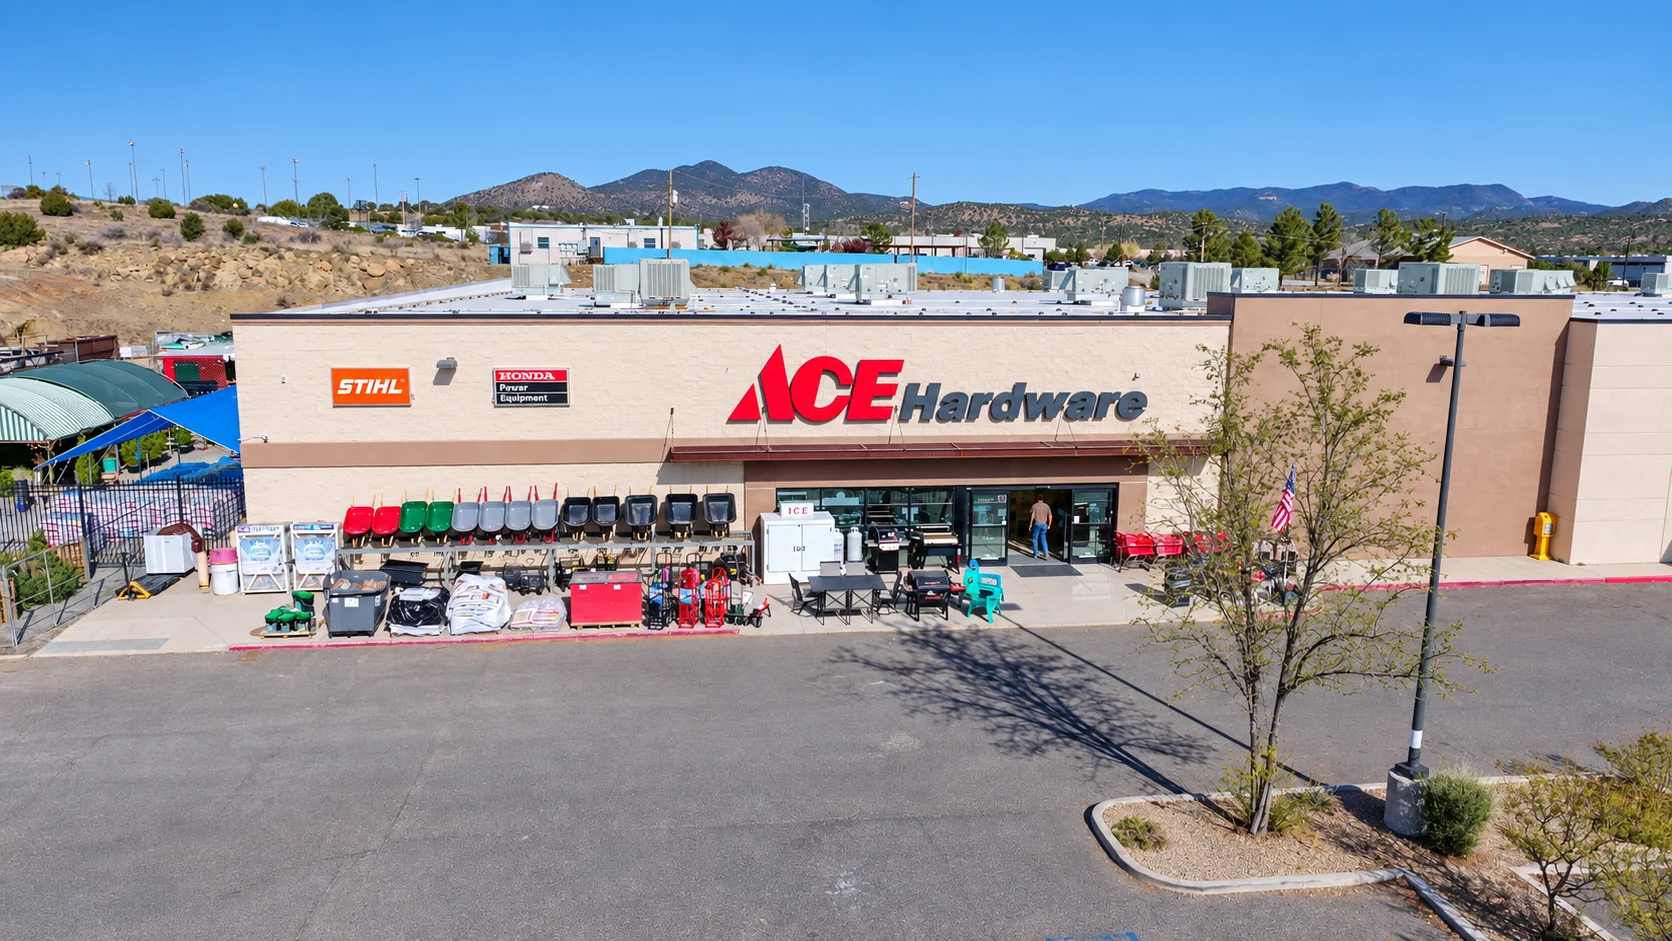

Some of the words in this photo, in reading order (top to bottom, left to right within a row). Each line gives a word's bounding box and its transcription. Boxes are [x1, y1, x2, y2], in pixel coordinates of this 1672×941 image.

[499, 372, 556, 380] HONDA
[337, 379, 403, 394] STIHL
[726, 344, 905, 422] ACE
[899, 382, 1148, 421] Hardware
[500, 394, 549, 403] Equipment
[788, 507, 808, 515] ICE
